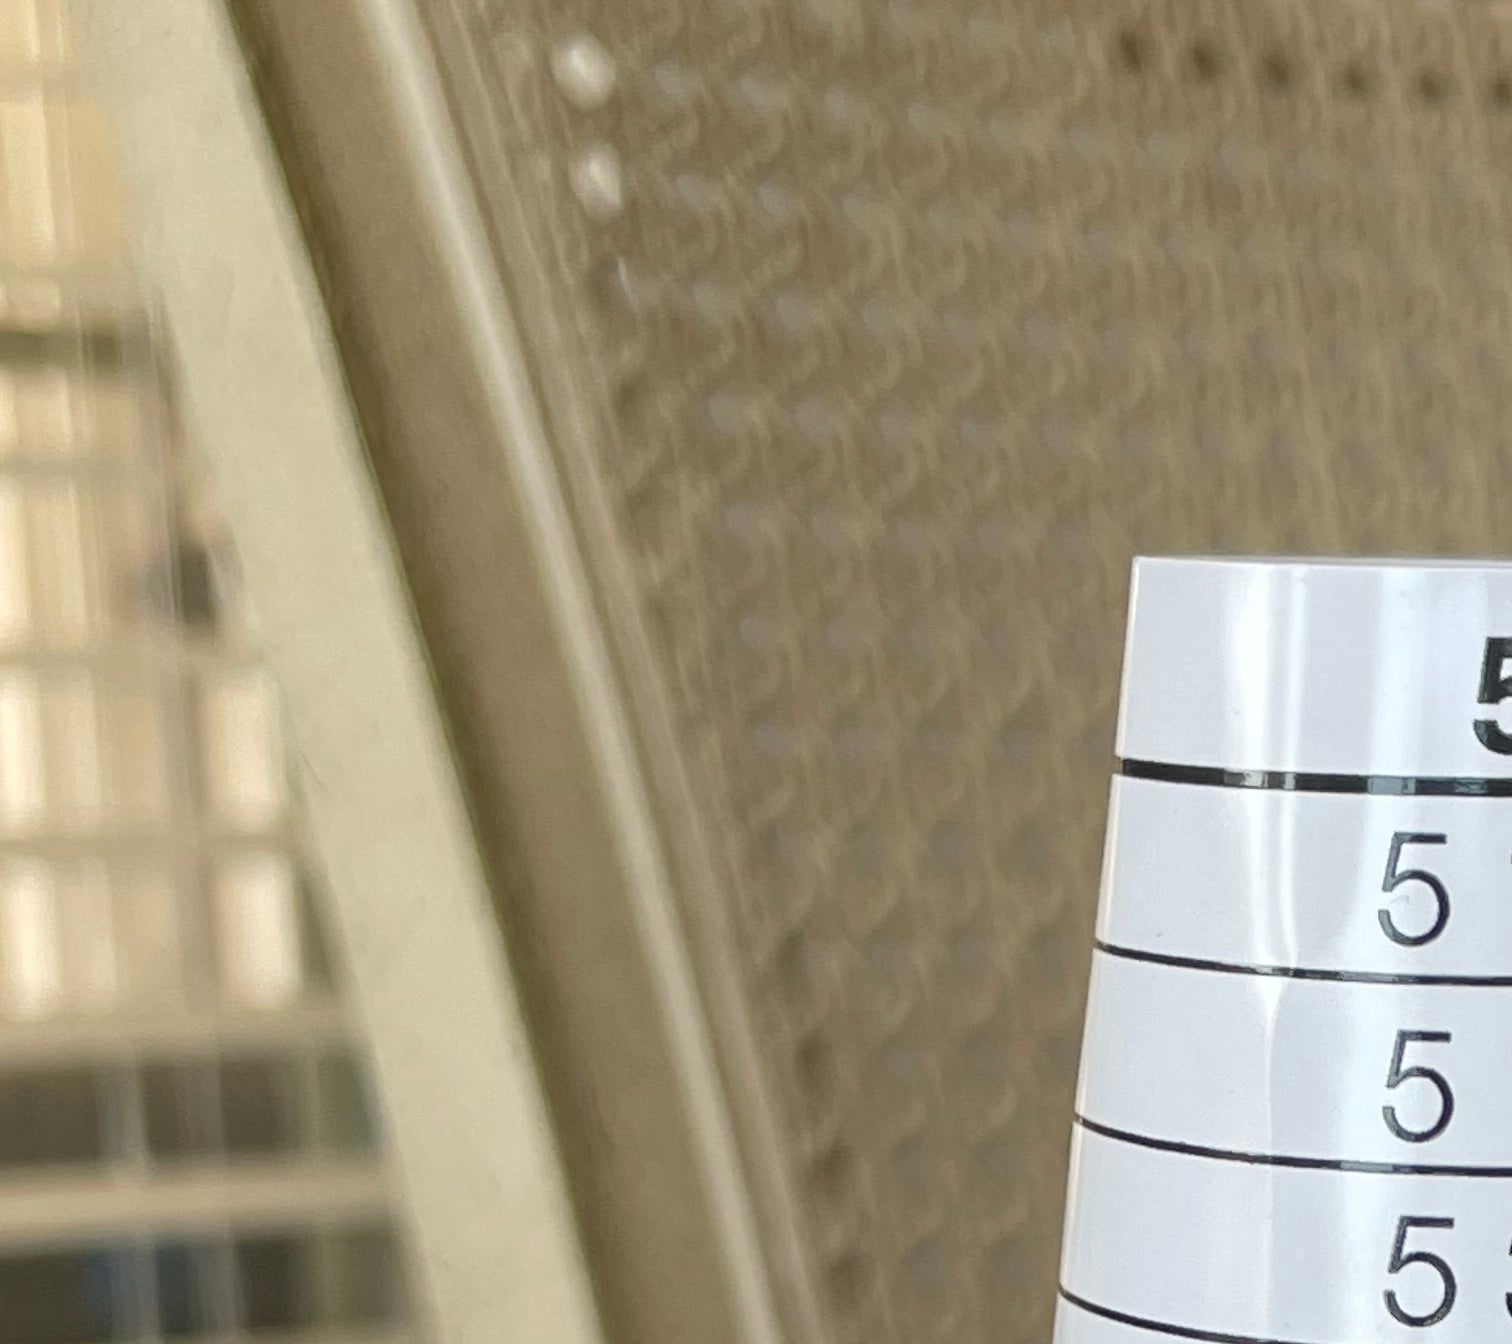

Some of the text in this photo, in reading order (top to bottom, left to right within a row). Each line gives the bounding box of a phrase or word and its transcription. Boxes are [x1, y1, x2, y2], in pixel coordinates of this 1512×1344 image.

[1377, 831, 1451, 948] 5
[1381, 1029, 1455, 1144] 5
[1383, 1215, 1458, 1328] 5
